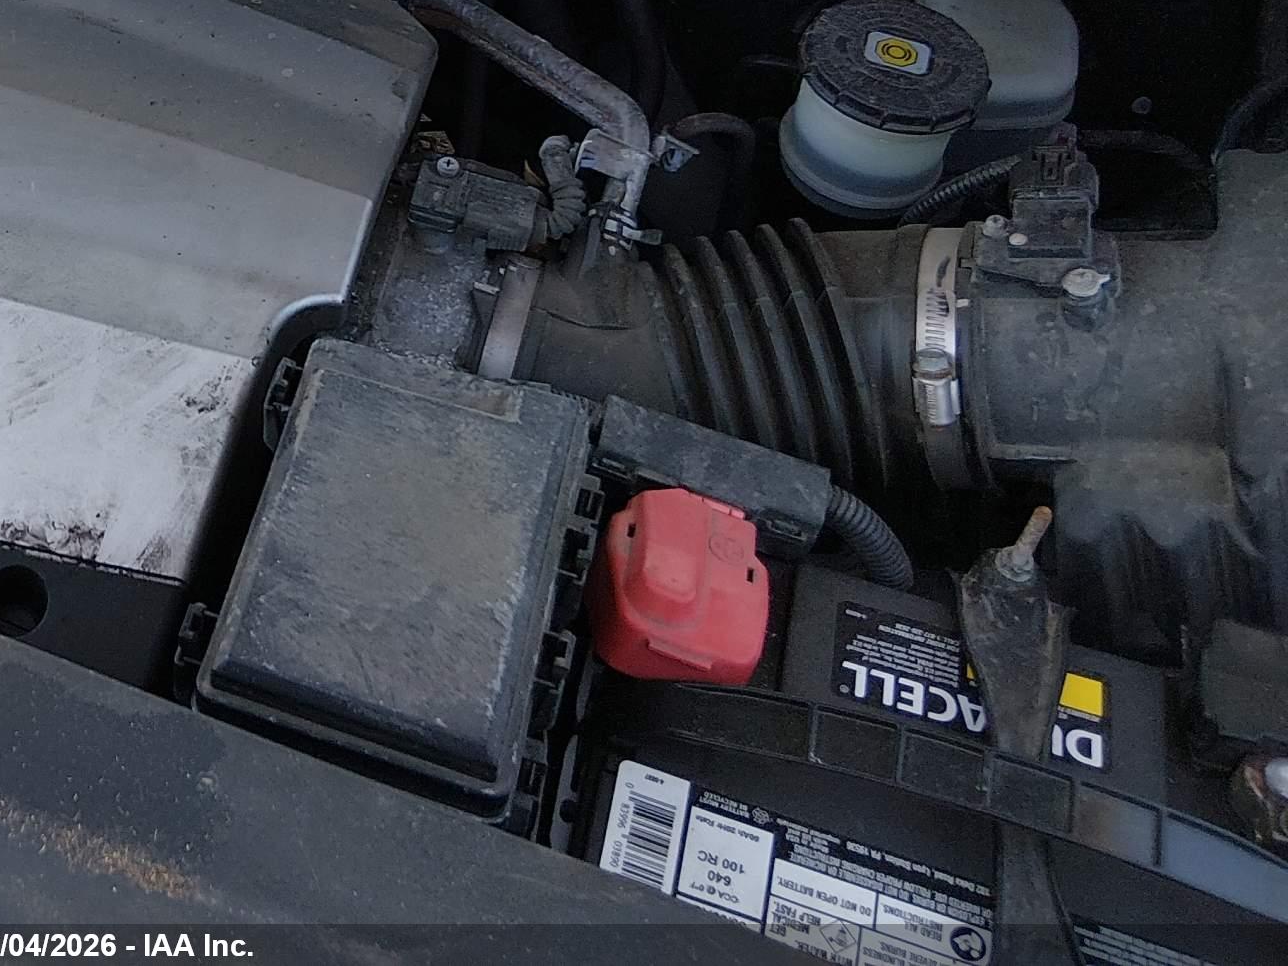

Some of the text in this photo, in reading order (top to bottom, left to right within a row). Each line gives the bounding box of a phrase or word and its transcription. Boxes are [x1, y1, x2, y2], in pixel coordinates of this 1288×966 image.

[842, 661, 1103, 769] DACELL
[703, 791, 736, 806] RECYCLED
[696, 849, 744, 874] 100 RC
[706, 869, 731, 886] 640
[706, 885, 715, 895] @
[717, 890, 739, 903] CCA
[777, 875, 871, 916] DO NOT OPEN BATTERY.
[771, 911, 809, 934] MEDICAL
[774, 901, 820, 925] HELP FAST.
[768, 923, 786, 936] GET
[904, 921, 941, 941] READ ALL
